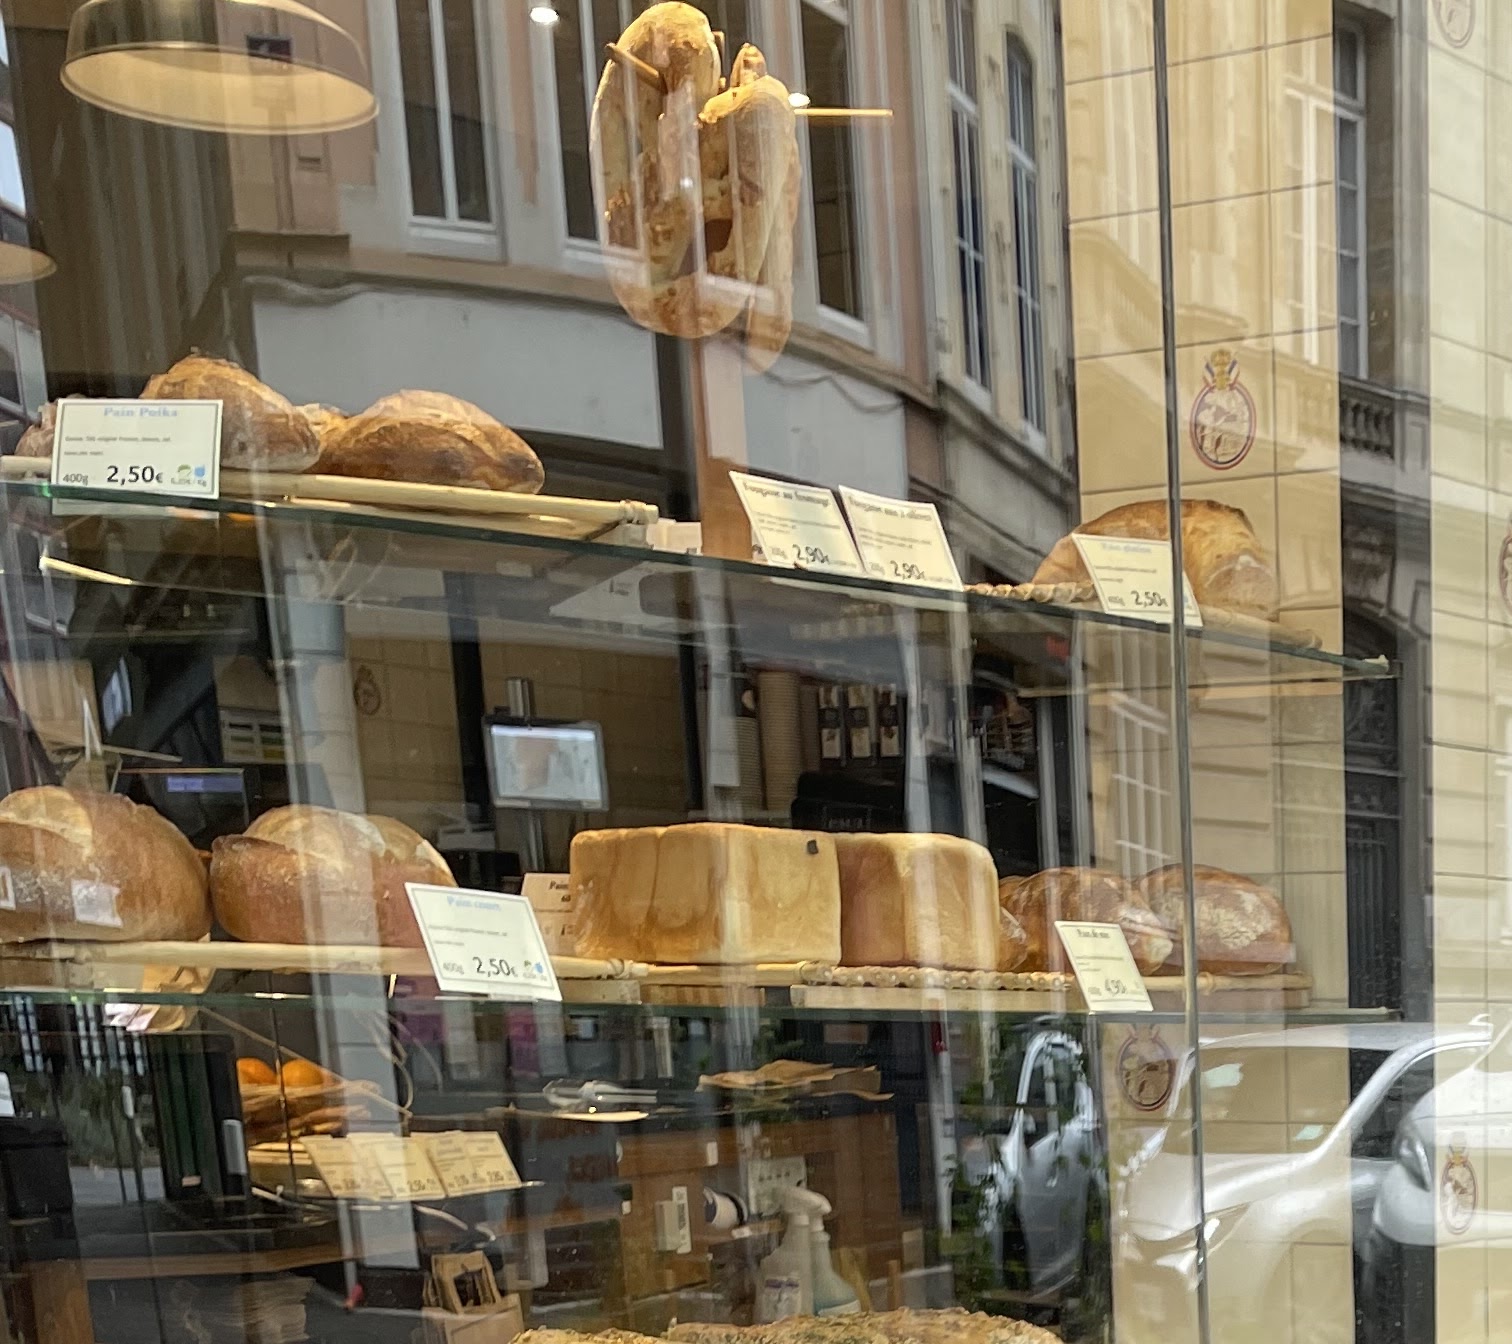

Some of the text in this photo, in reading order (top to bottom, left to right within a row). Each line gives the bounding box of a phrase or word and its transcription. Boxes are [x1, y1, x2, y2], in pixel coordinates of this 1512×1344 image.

[104, 407, 134, 417] Pain
[63, 473, 88, 485] 400g
[106, 465, 164, 486] 2,50€
[473, 956, 518, 978] 2,50€
